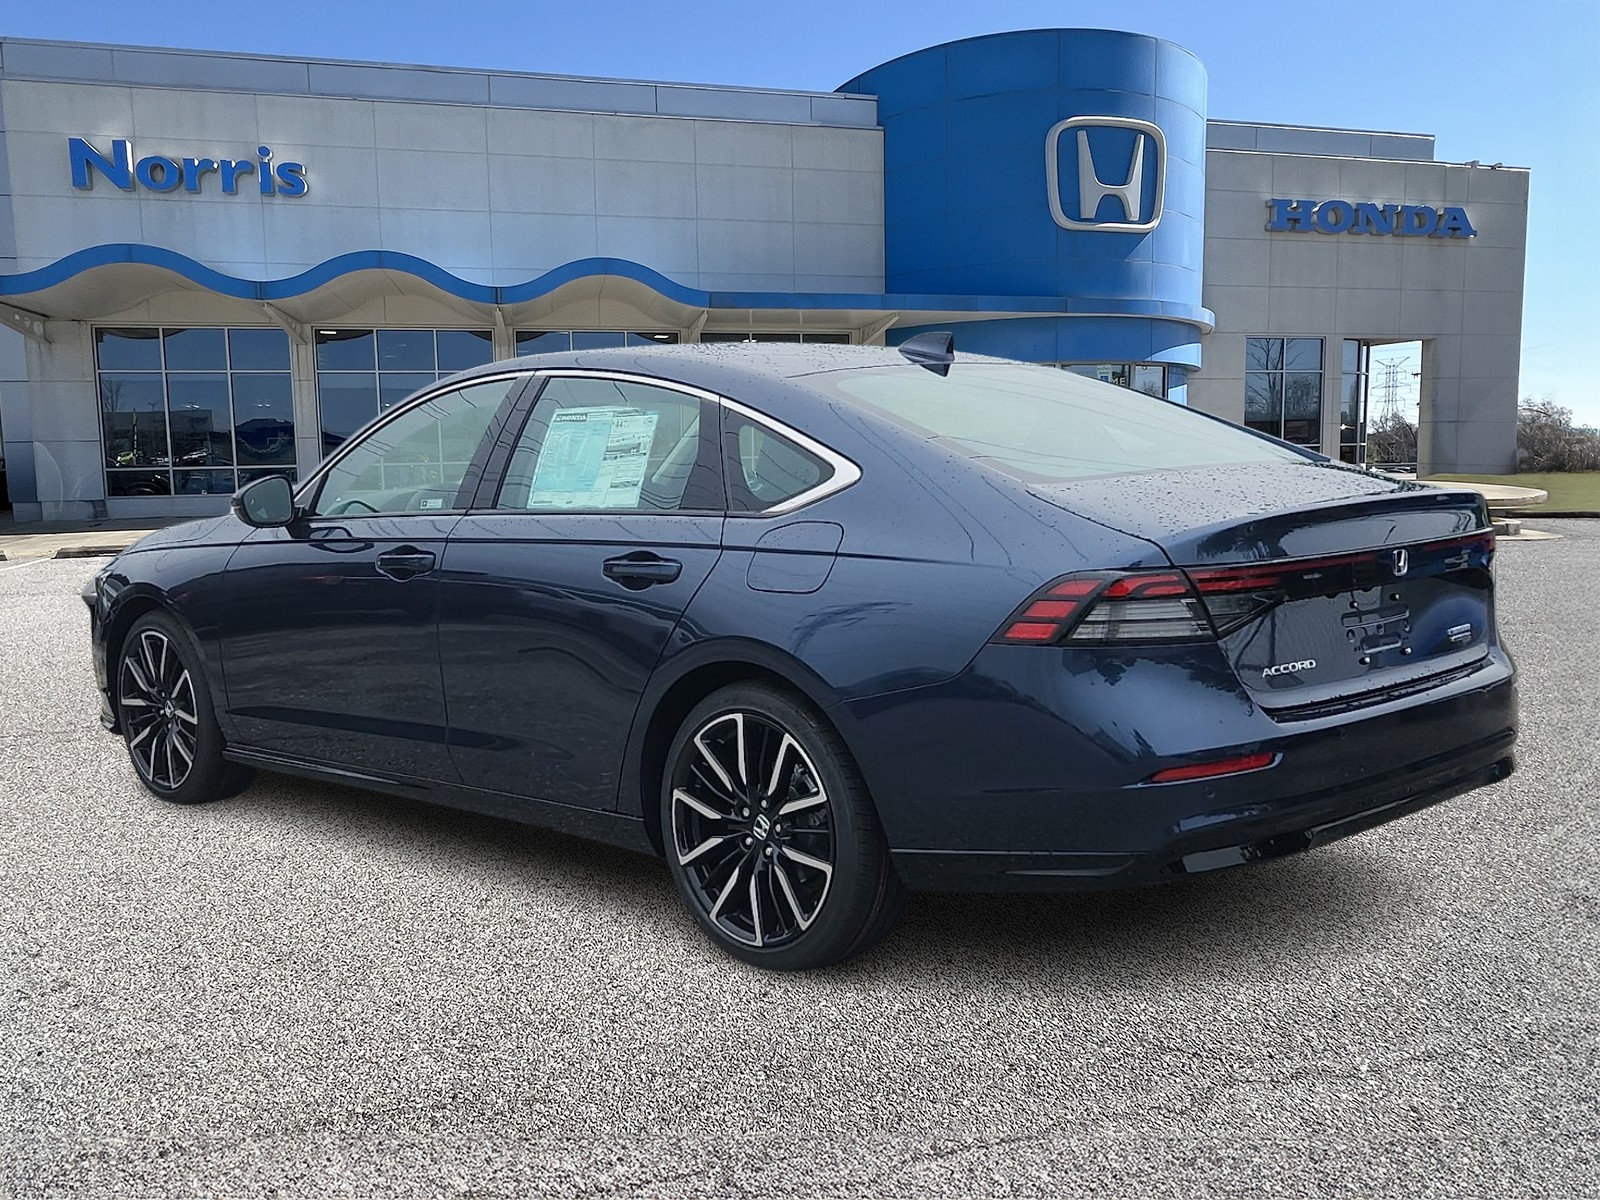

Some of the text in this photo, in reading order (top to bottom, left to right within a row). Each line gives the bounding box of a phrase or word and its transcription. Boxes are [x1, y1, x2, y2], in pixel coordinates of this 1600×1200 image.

[68, 137, 309, 198] Norris
[1265, 199, 1477, 239] HONDA
[1261, 658, 1317, 678] ACCORD
